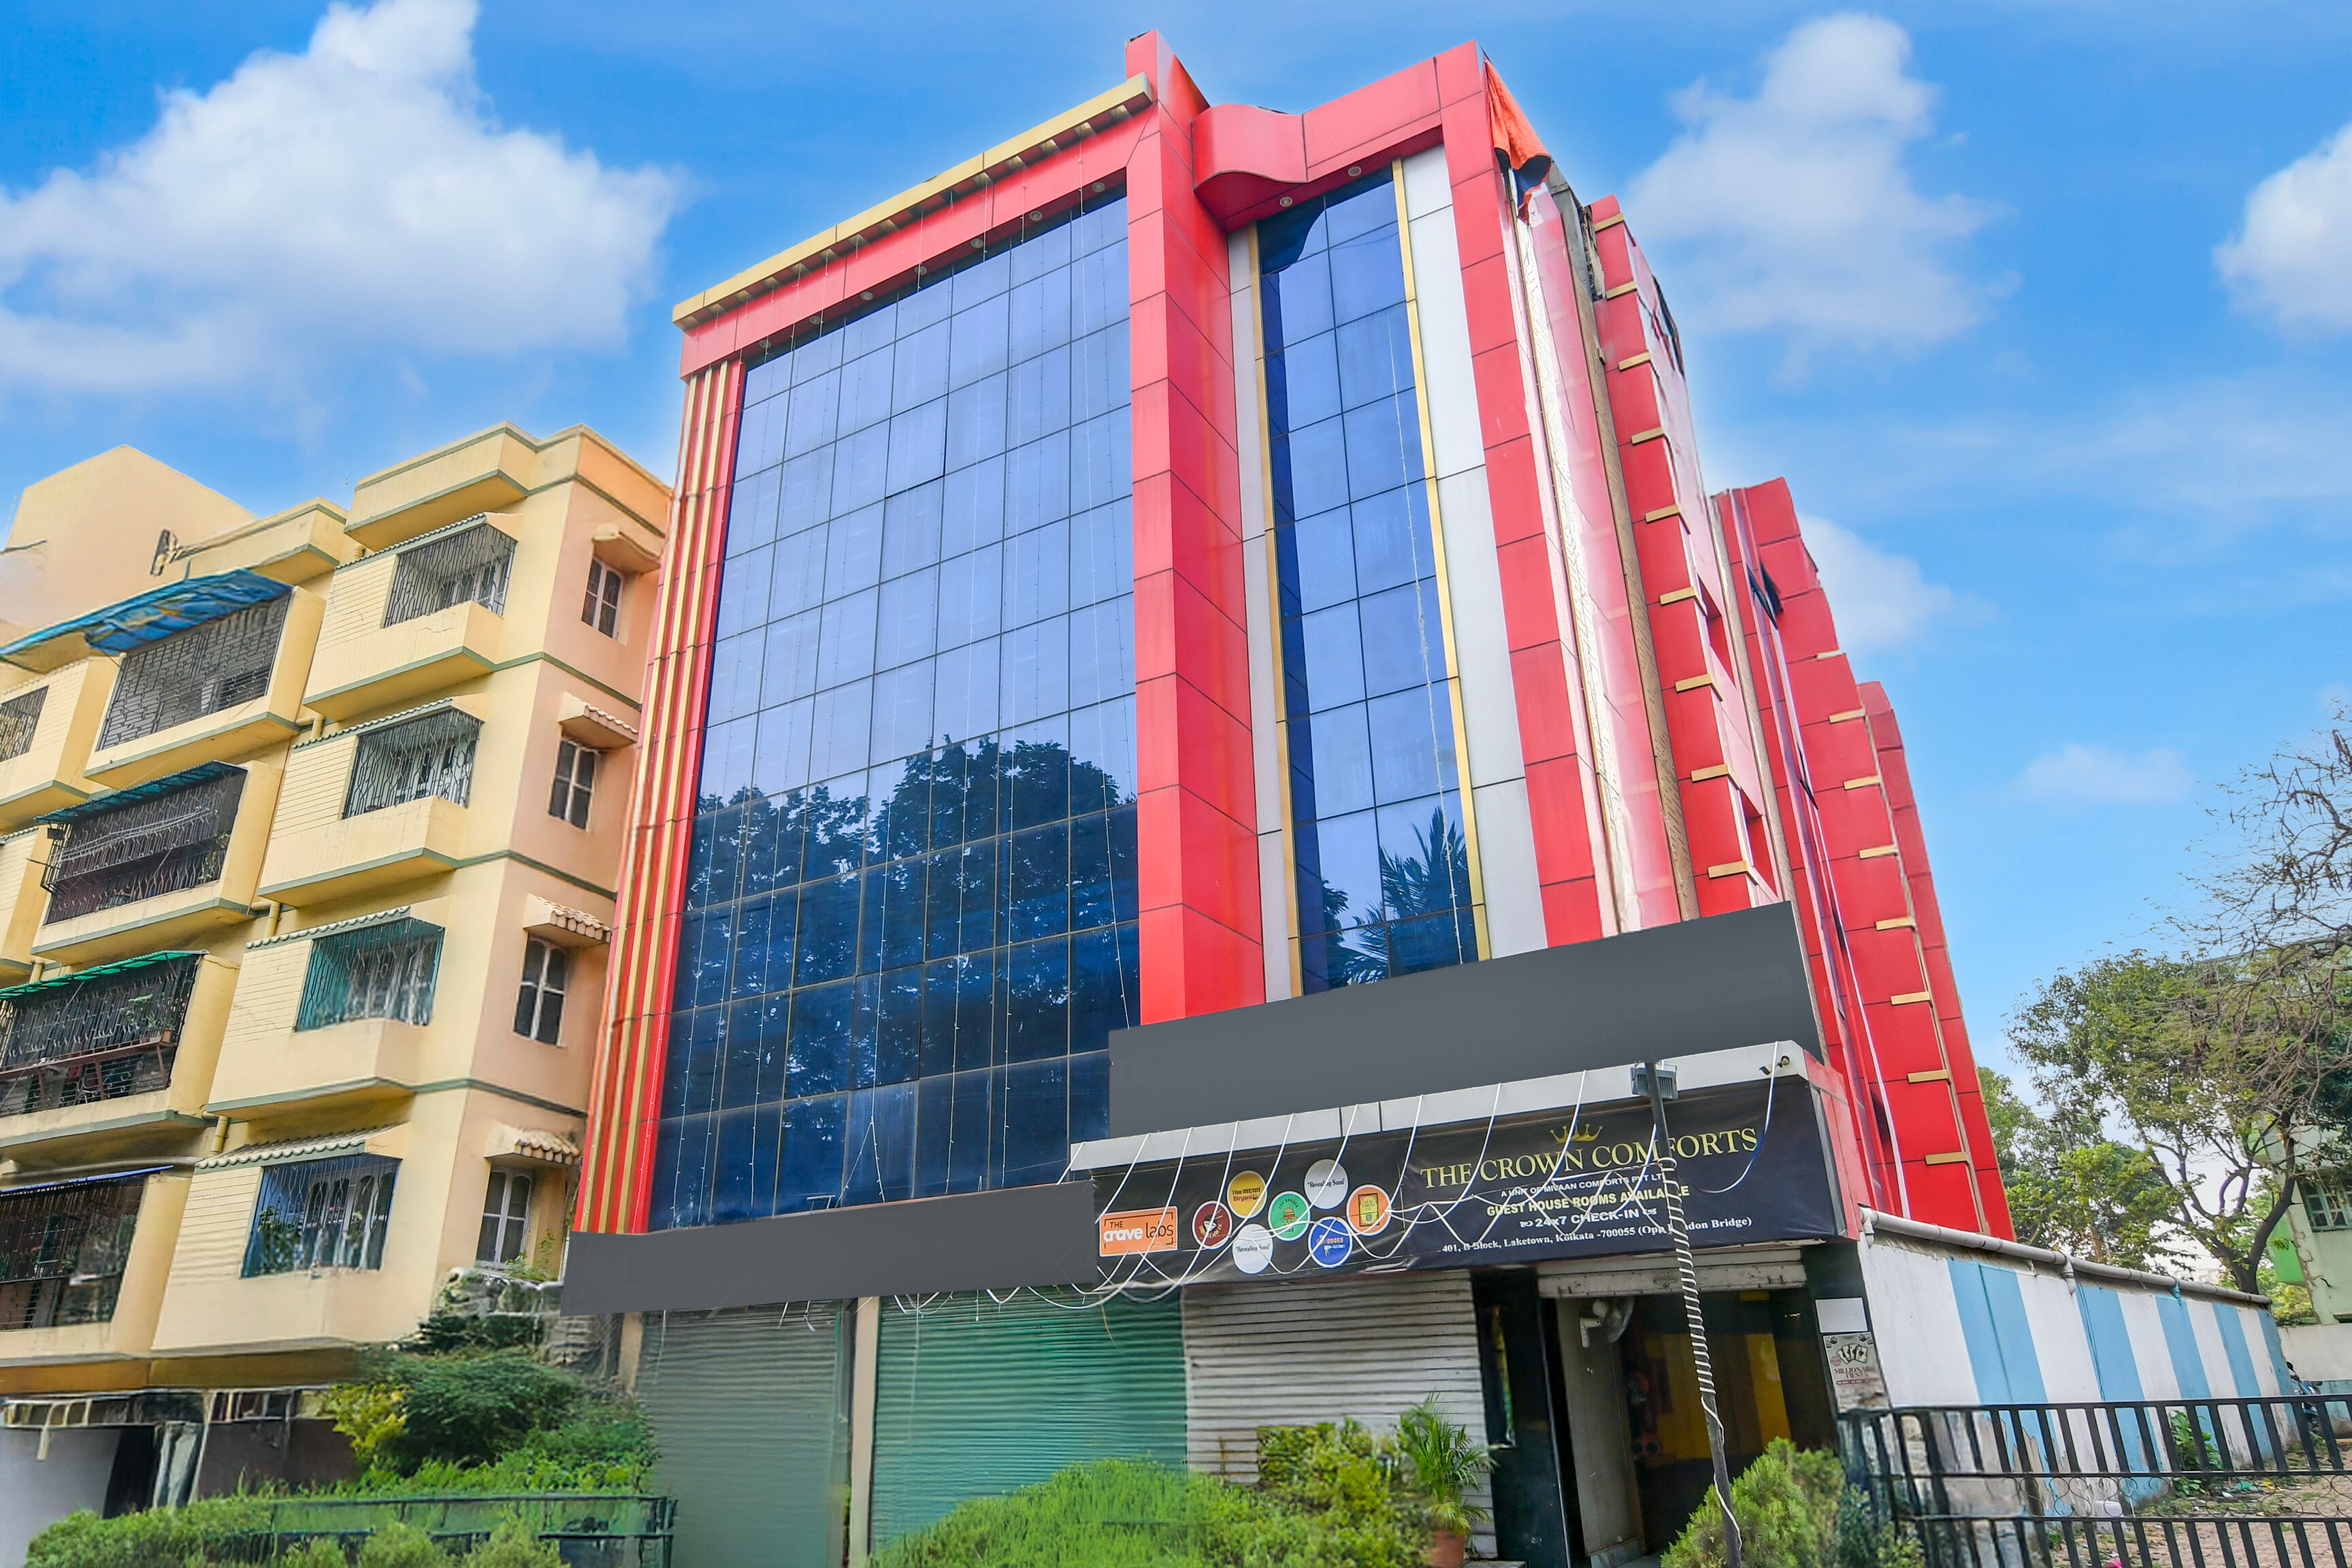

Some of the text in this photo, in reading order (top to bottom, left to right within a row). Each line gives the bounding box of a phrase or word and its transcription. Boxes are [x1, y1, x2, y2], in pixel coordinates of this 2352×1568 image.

[1420, 1162, 1472, 1188] THE
[1480, 1148, 1584, 1181] CROWN
[1509, 1188, 1529, 1196] UNIT
[1651, 1173, 1665, 1181] LT
[1486, 1186, 1690, 1216] GUEST HOUSE ROOMS AVAILAE
[1110, 1220, 1124, 1229] THE
[1535, 1208, 1640, 1228] 24x7 CHECK-IN
[1103, 1221, 1174, 1243] crave labs
[1442, 1243, 1461, 1252] 401,
[1503, 1236, 1554, 1247] Laketown,
[1555, 1232, 1595, 1243] Kolkata
[1597, 1227, 1635, 1238] -700055
[1711, 1216, 1752, 1228] Bridge)
